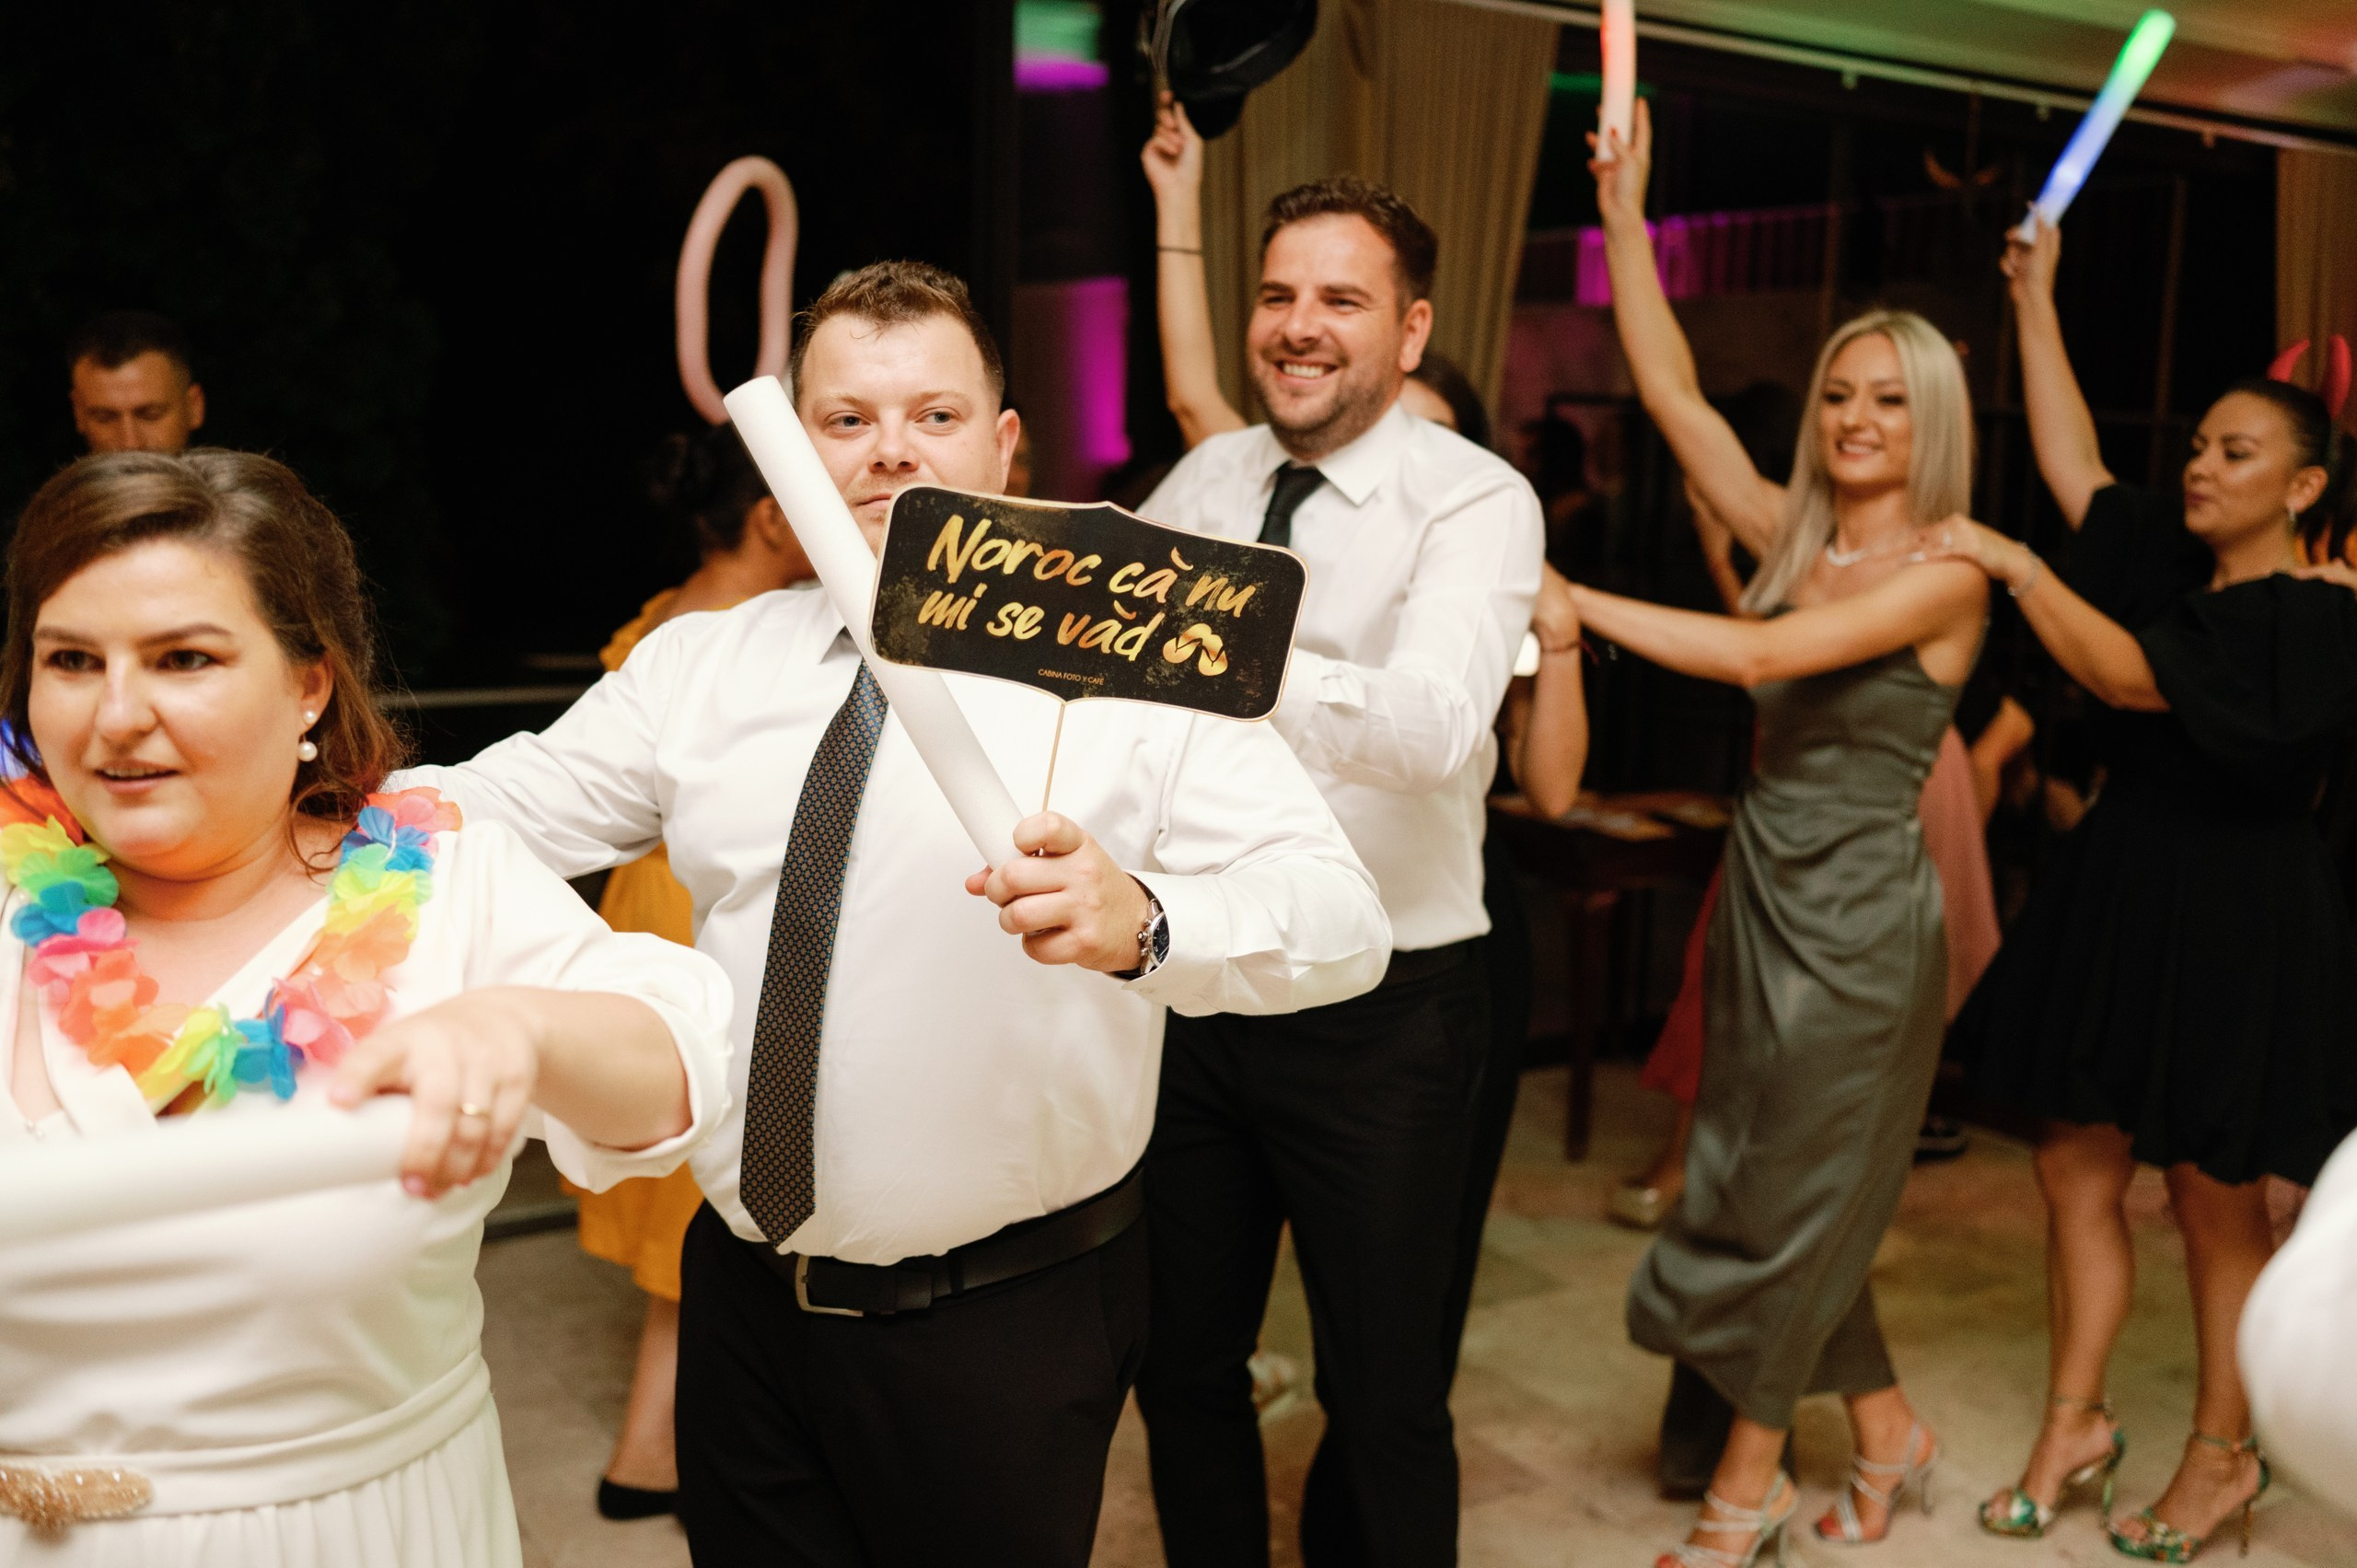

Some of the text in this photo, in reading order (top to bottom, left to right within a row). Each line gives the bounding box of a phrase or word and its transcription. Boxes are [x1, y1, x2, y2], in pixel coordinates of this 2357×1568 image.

[926, 514, 1257, 618] Noroc că nu
[918, 582, 1167, 662] mi se văd
[1038, 668, 1062, 679] CABINA
[1062, 672, 1082, 682] FOTO
